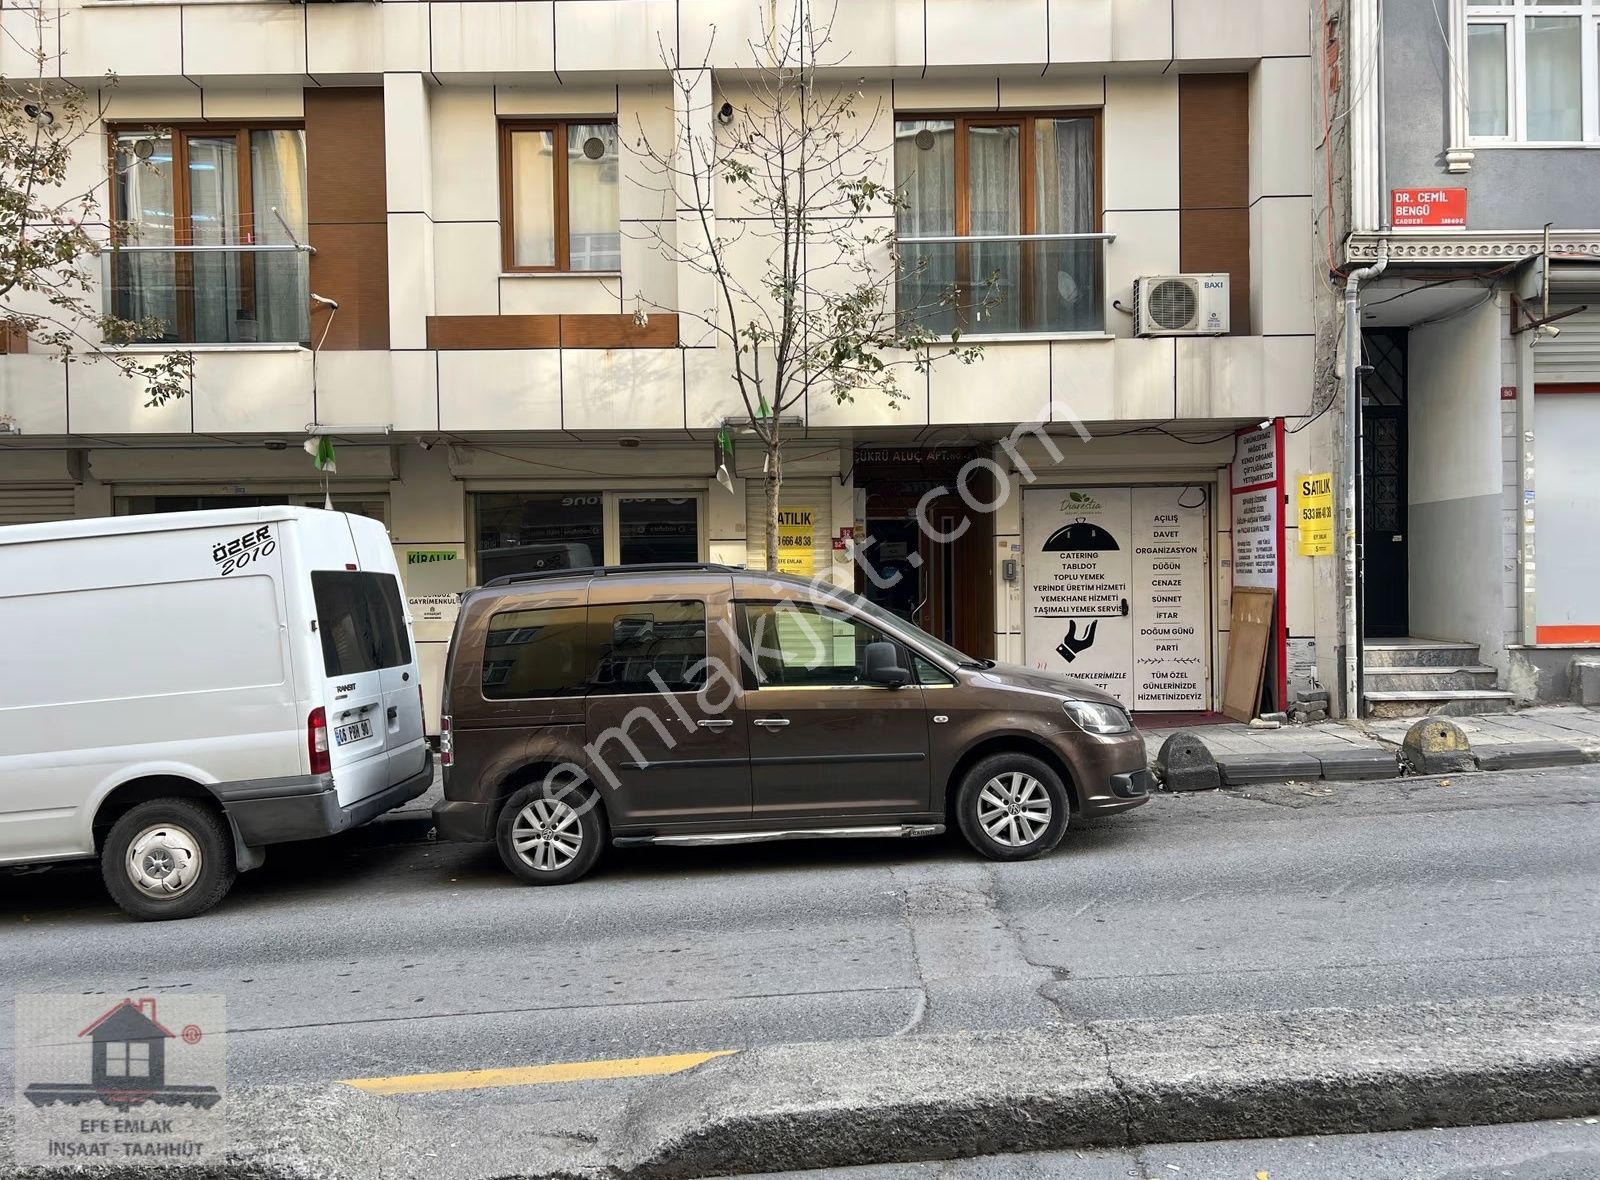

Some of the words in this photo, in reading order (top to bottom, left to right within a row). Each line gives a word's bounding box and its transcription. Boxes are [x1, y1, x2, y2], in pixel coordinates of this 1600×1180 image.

[1396, 193, 1413, 203] DR.
[1418, 191, 1448, 203] CEMİL
[1396, 204, 1430, 216] BENGÜ
[1204, 281, 1224, 289] BAXI
[893, 451, 922, 463] ALUÇ
[1303, 479, 1331, 496] SATILIK
[1303, 508, 1316, 519] 533
[778, 512, 811, 526] ATILIK
[1154, 515, 1179, 523] AÇILIŞ
[212, 525, 271, 562] ÖZER
[782, 536, 794, 546] 666
[794, 536, 802, 546] 48
[803, 536, 811, 546] 38
[1136, 546, 1198, 554] ORGANİZASYON
[221, 541, 276, 576] 2010
[1152, 562, 1181, 570] DÜĞÜN
[1033, 584, 1064, 592] YERİNDE
[1066, 583, 1094, 591] ÜRETİM
[1095, 583, 1126, 591] HİZMETİ
[1088, 594, 1118, 602] HİZMETİ
[1152, 595, 1182, 603] SÜNNET
[1034, 607, 1069, 615] TAŞIMALI
[1140, 627, 1170, 635] DOĞUM
[1172, 627, 1194, 635] GÜNÜ
[1152, 671, 1168, 679] TÜM
[1169, 671, 1188, 679] ÖZEL
[335, 683, 356, 693] TRANSIT
[1142, 681, 1197, 689] GÜNLERİNİZDE
[1137, 693, 1202, 701] HİZMETİNİZDEYİZ
